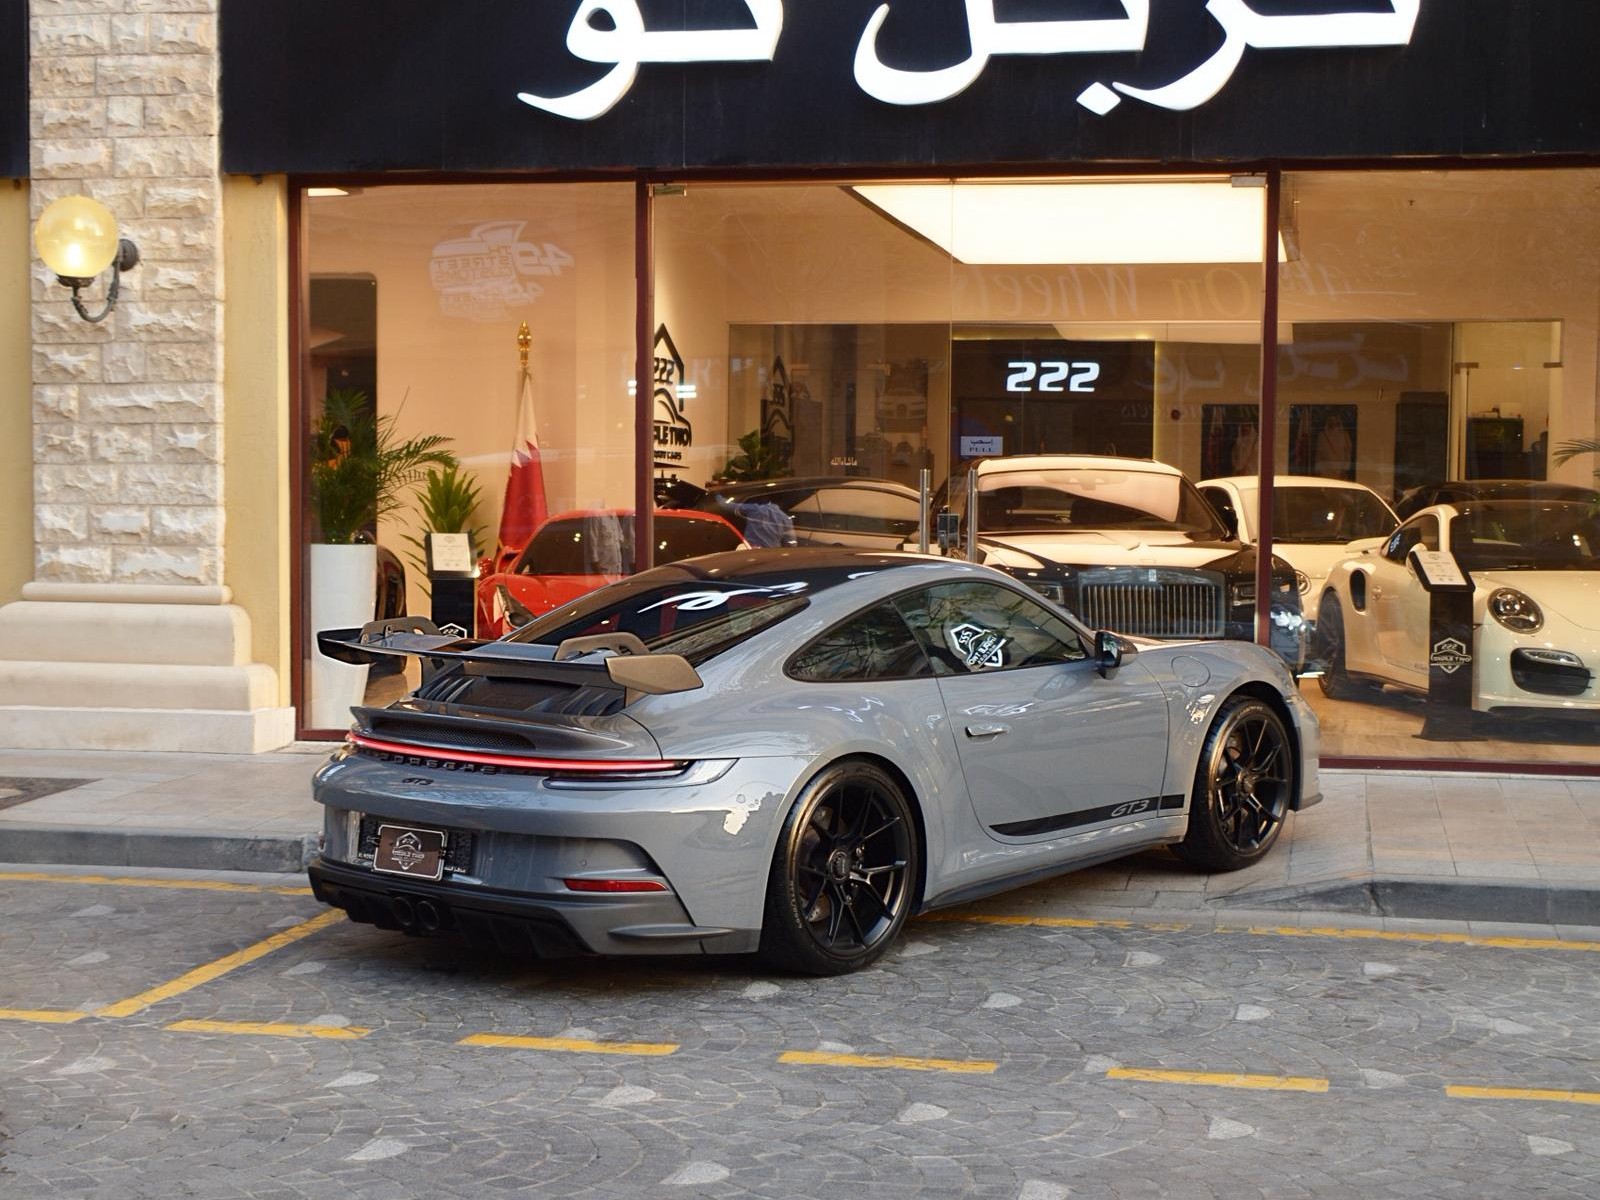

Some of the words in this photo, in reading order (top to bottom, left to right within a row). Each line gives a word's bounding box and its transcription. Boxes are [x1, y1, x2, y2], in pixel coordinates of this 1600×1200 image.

[1006, 361, 1100, 393] 222
[402, 777, 435, 786] GT3
[1110, 799, 1150, 817] GT3
